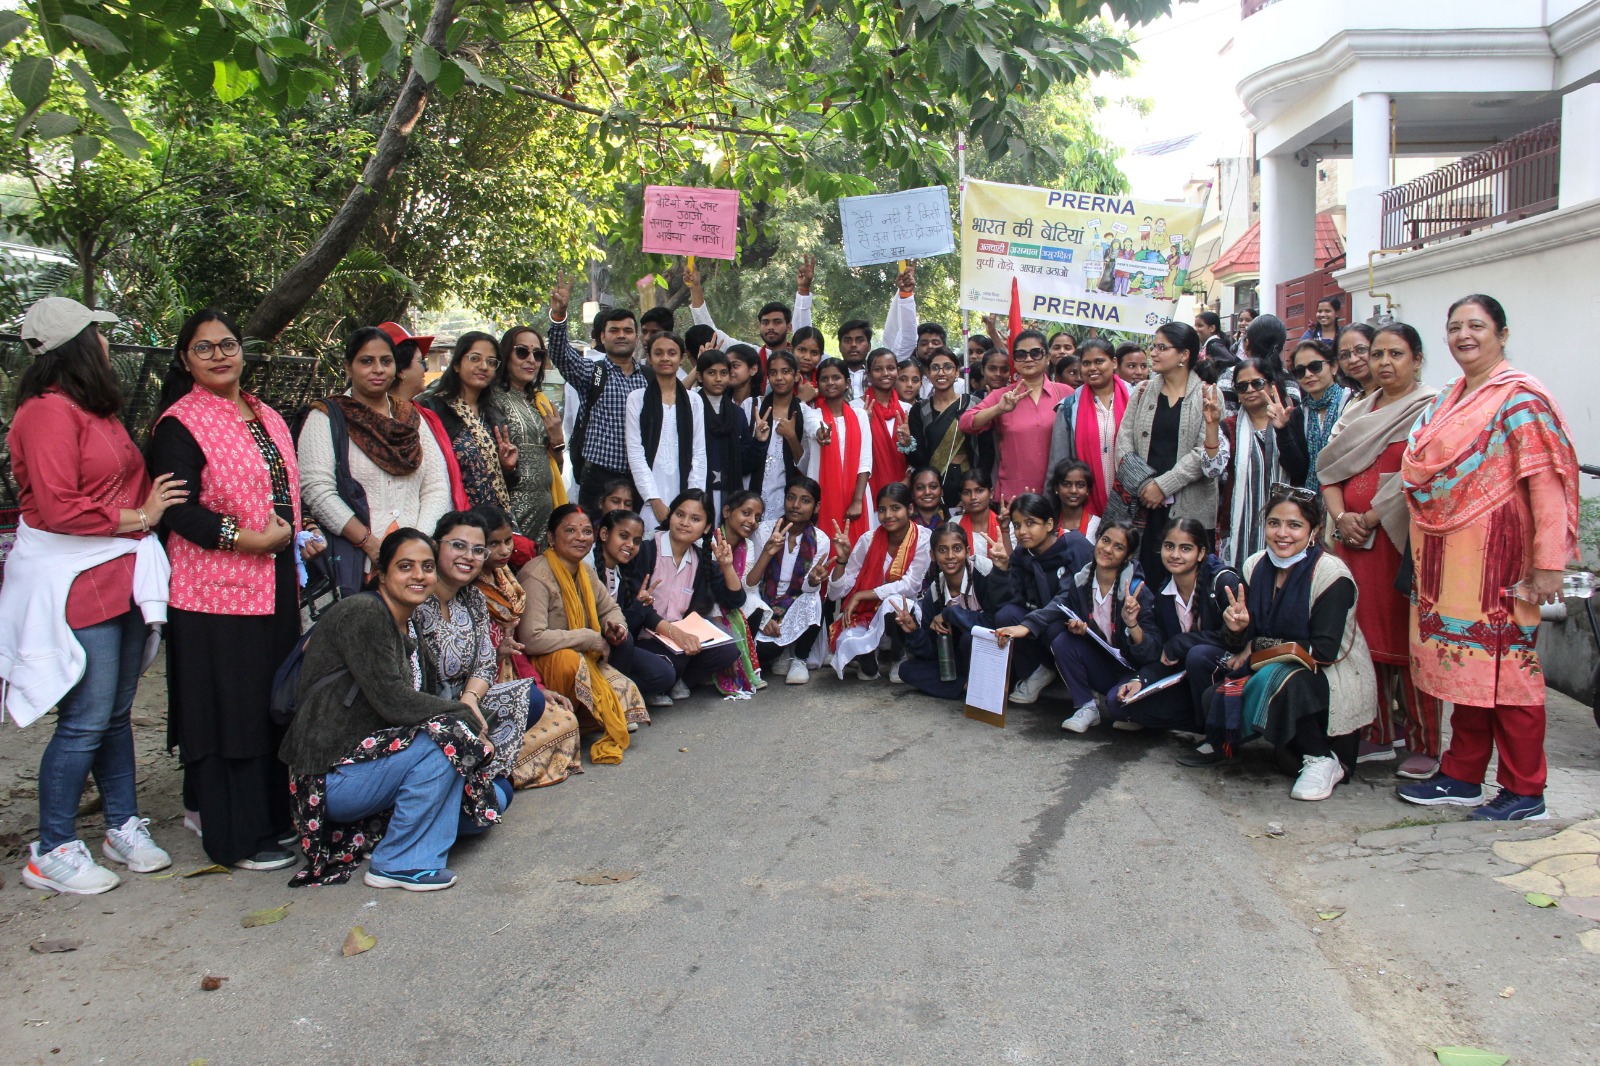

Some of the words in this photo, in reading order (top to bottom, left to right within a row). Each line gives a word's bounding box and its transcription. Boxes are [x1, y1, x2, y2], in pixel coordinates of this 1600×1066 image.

[1048, 191, 1135, 215] PRERNA
[972, 217, 1007, 235] भारत
[1012, 218, 1034, 238] की
[1040, 219, 1085, 245] बेटियां
[1009, 245, 1038, 257] असमान
[1041, 249, 1072, 260] असुरक्षित
[976, 257, 994, 270] चुप्पी
[1045, 266, 1069, 278] उठाओ
[1032, 295, 1120, 323] PRERNA
